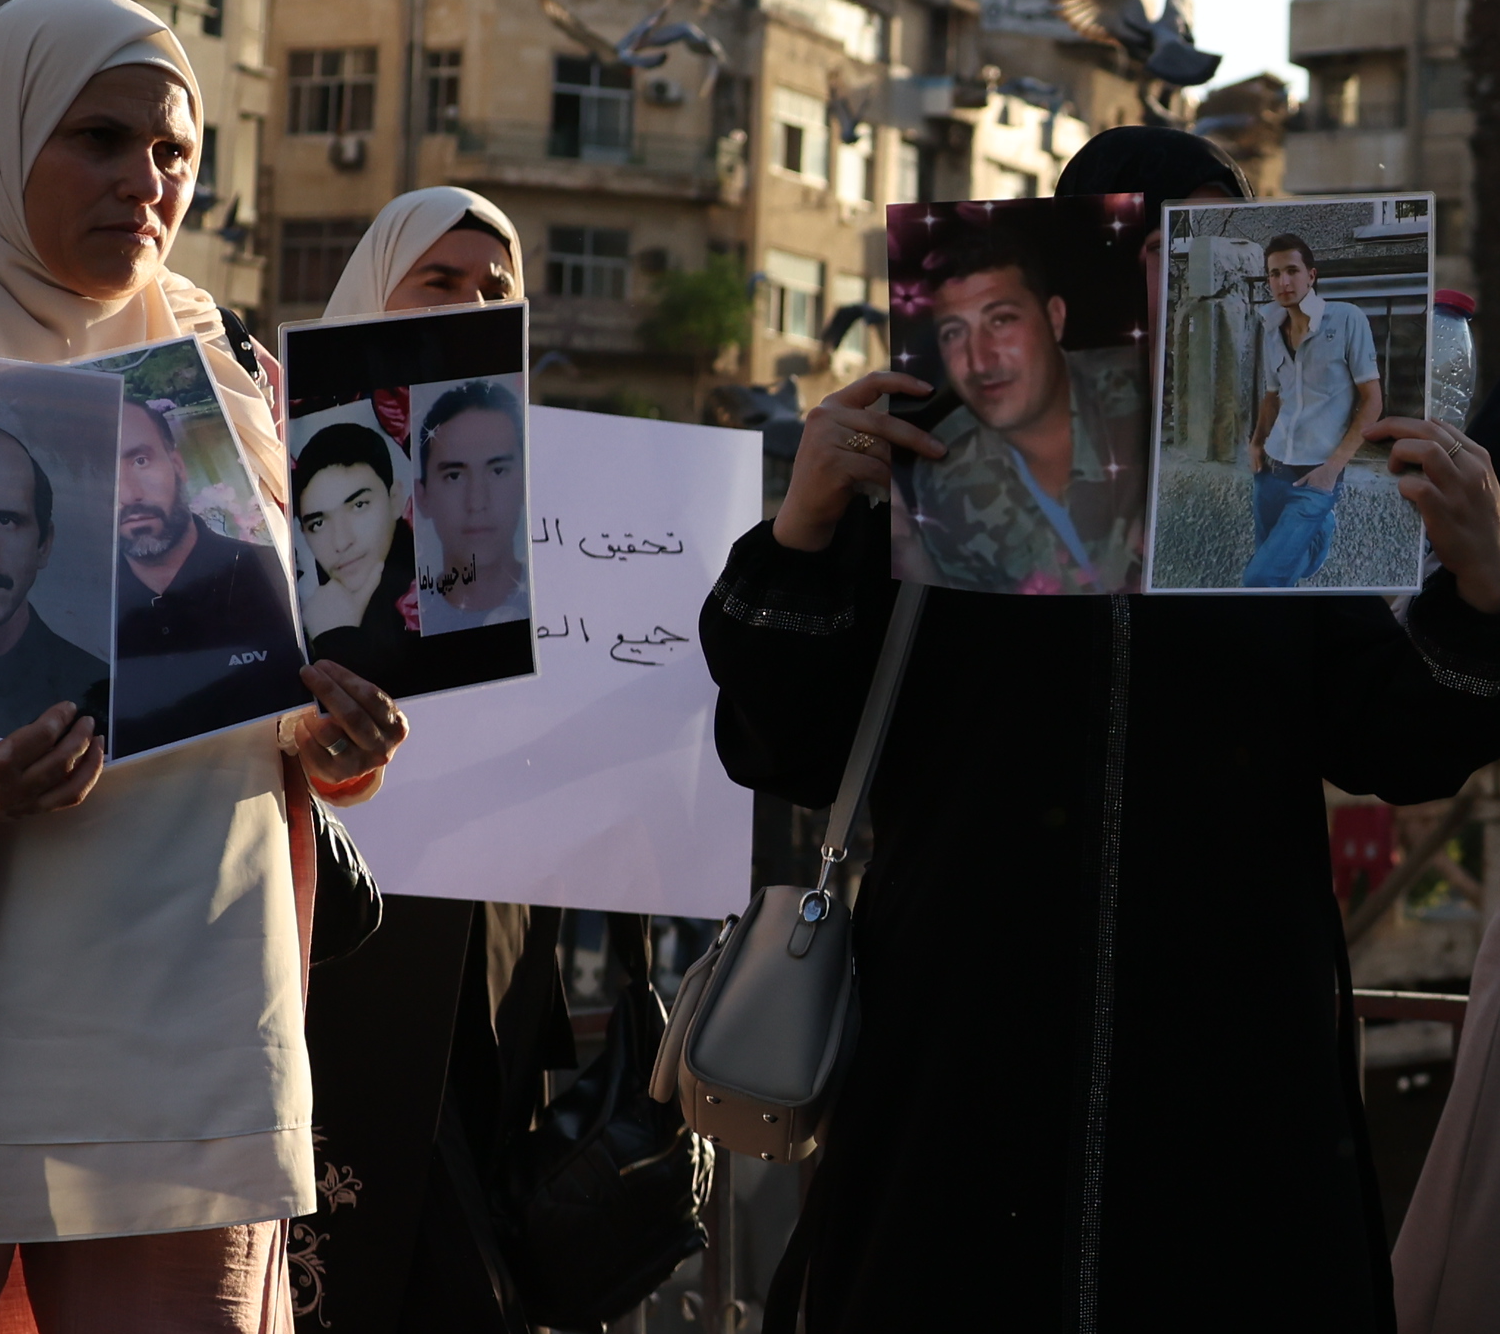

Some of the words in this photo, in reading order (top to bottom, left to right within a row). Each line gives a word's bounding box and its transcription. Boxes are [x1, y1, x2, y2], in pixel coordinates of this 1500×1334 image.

[579, 531, 684, 562] تحقيق
[228, 650, 268, 666] ADV
[610, 625, 689, 666] جميع
